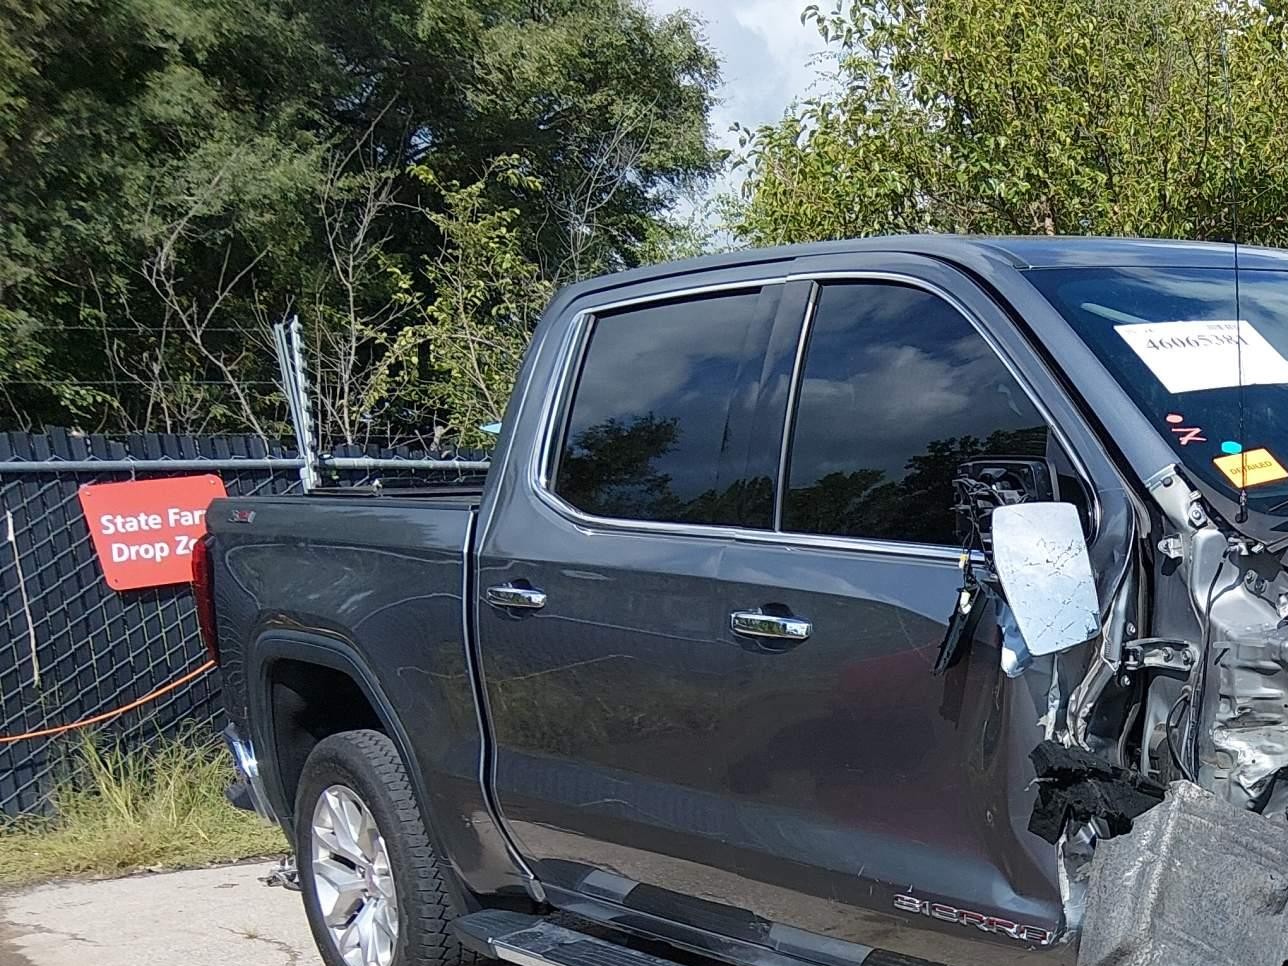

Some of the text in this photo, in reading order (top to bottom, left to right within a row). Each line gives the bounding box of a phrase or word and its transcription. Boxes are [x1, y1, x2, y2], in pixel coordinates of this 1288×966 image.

[1146, 333, 1249, 350] 46065381
[101, 507, 206, 535] State Far
[112, 541, 170, 563] Drop
[893, 893, 1052, 946] SIERRA
